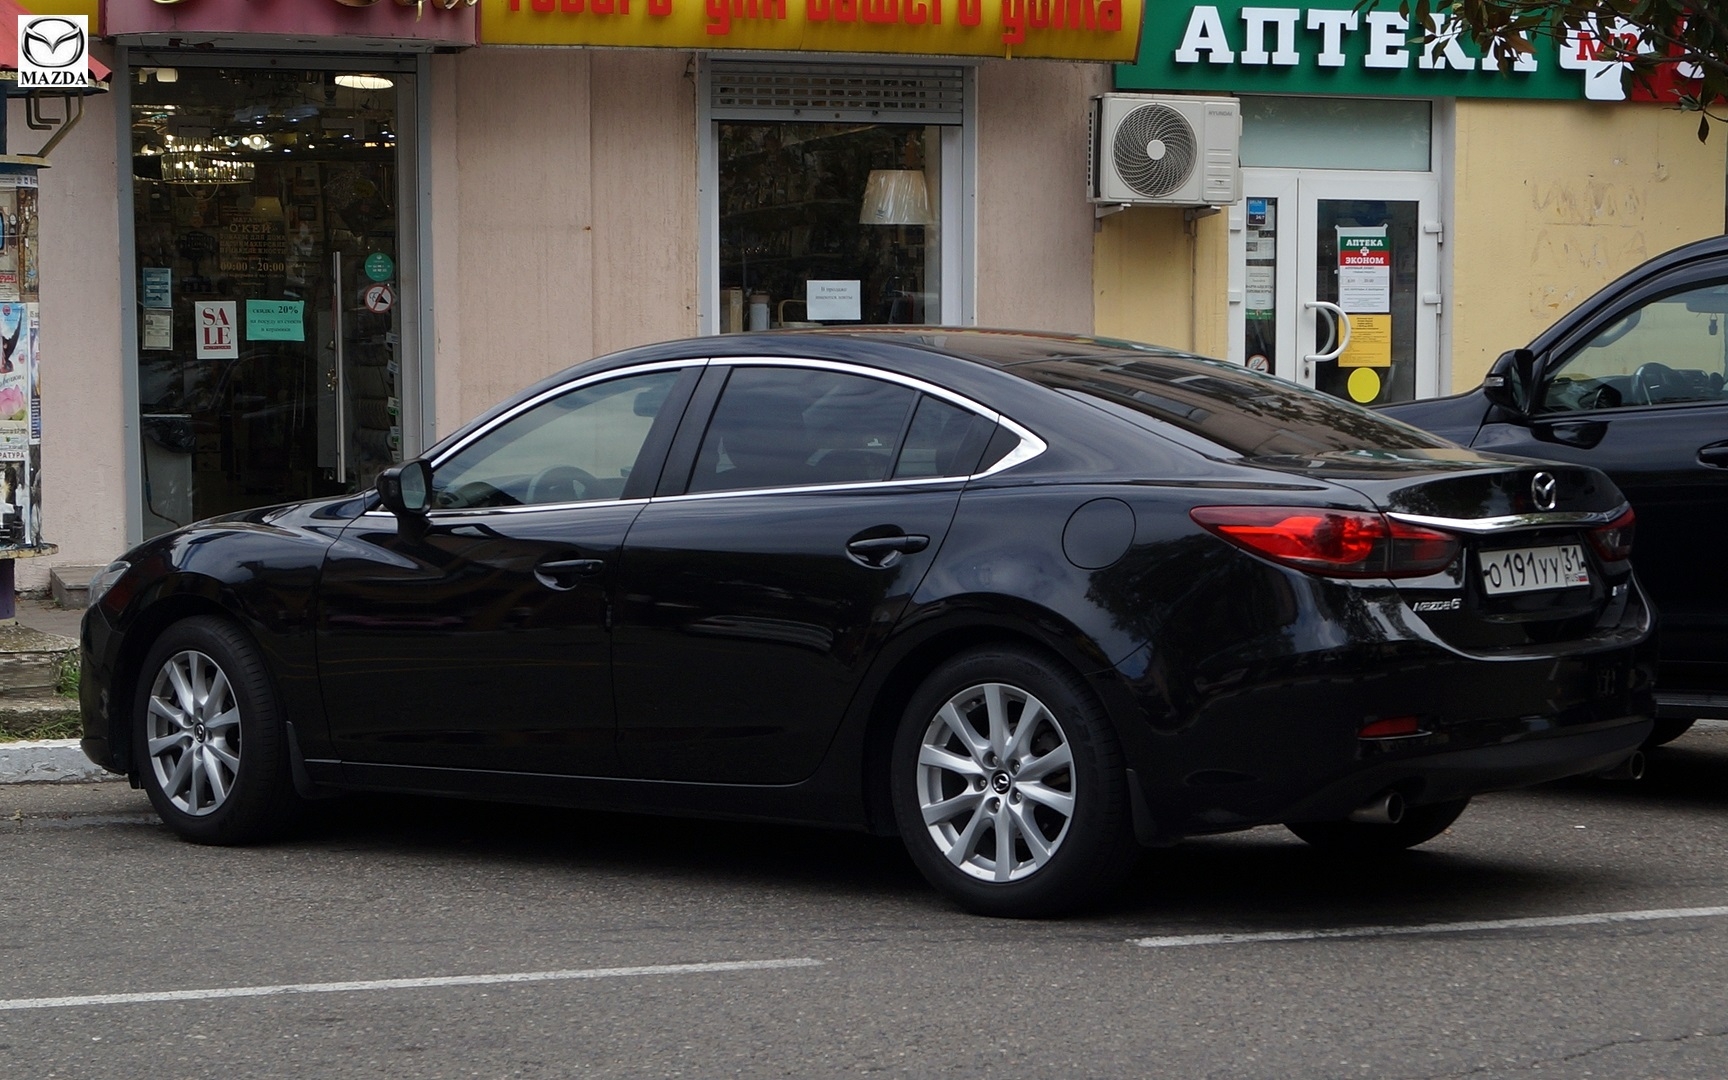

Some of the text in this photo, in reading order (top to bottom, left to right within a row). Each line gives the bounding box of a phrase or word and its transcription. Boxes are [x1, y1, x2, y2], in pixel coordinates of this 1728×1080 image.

[1346, 239, 1384, 247] АПТЕКА
[257, 262, 285, 271] 20:00
[278, 305, 299, 314] 20%
[1561, 547, 1581, 572] 31
